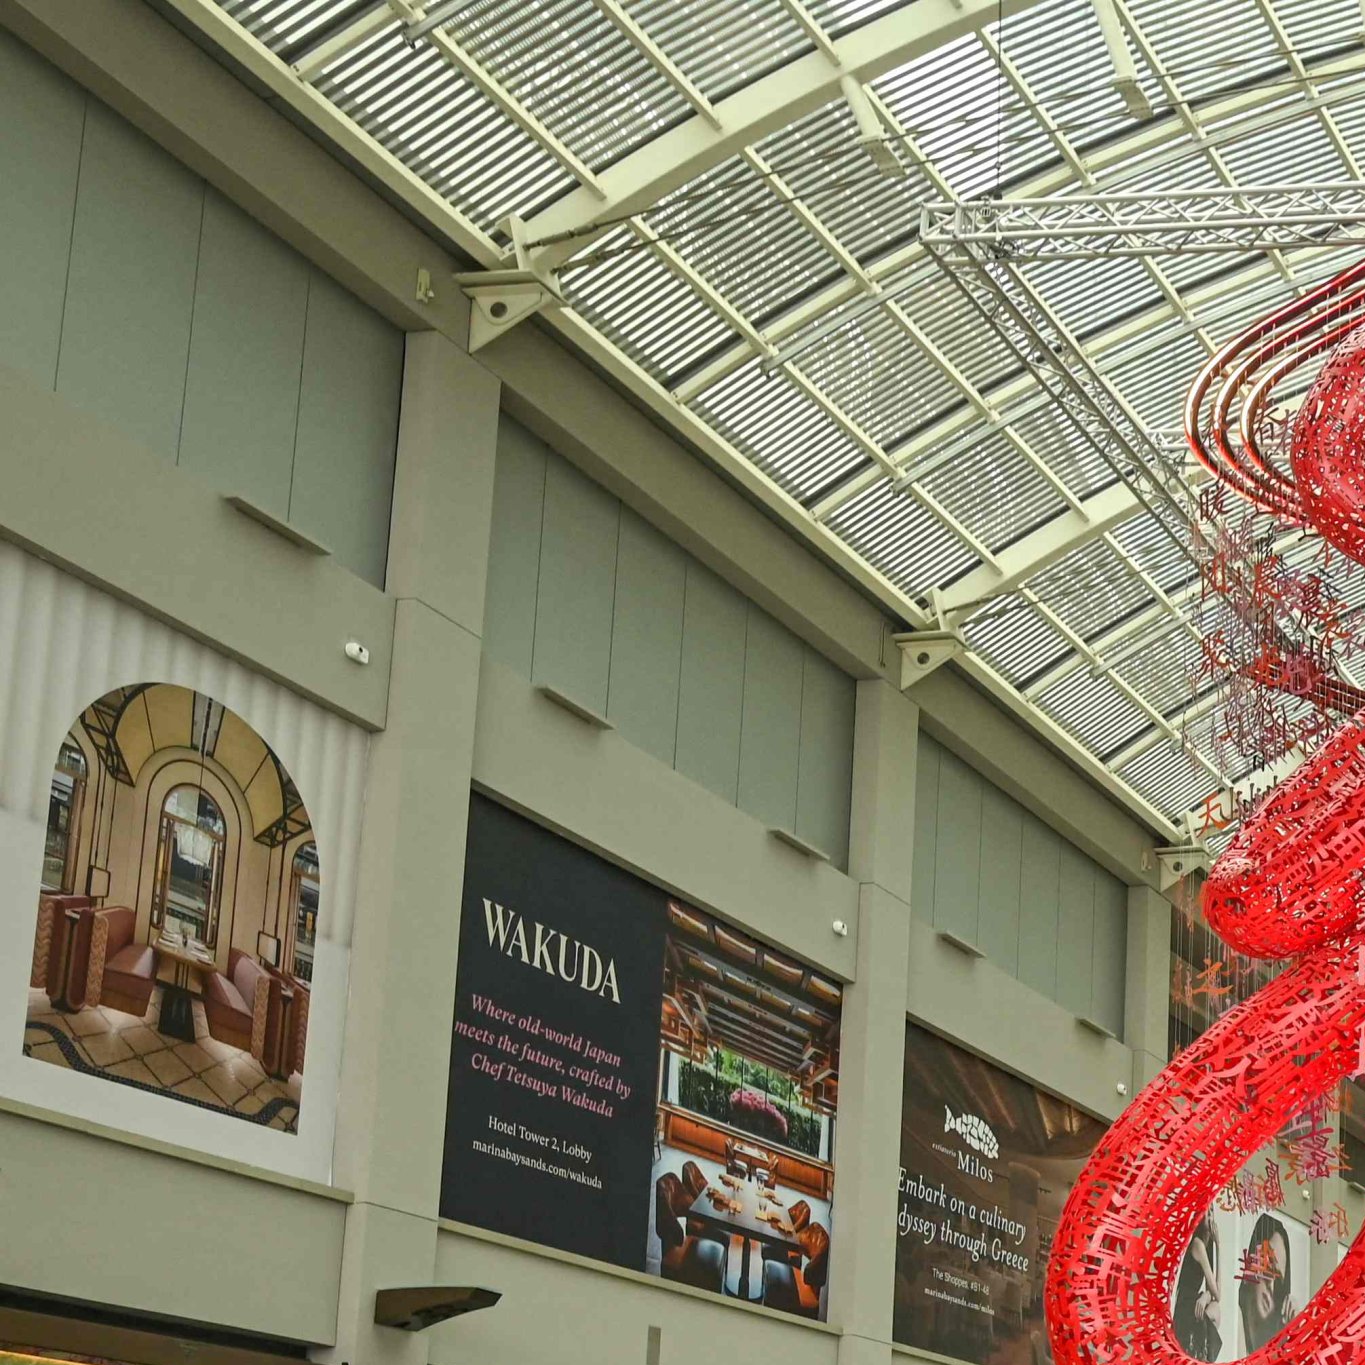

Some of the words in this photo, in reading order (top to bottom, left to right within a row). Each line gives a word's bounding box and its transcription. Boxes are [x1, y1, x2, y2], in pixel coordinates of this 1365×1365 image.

[483, 897, 621, 1004] WAKUDA
[454, 1020, 495, 1046] meets
[498, 1030, 518, 1054] the
[520, 1043, 565, 1075] future,
[569, 1064, 614, 1092] crafted
[616, 1081, 631, 1100] by
[472, 994, 515, 1026] Where
[518, 1013, 581, 1053] old-world
[583, 1040, 621, 1068] Japan
[471, 1053, 505, 1081] Chef
[506, 1065, 557, 1098] Tetsuya
[561, 1084, 613, 1118] Wakuda
[472, 1138, 602, 1189] marinabaysands.com/wakuda
[488, 1115, 516, 1137] Hotel
[519, 1125, 549, 1147] Tower
[552, 1137, 560, 1151] 2,
[563, 1141, 592, 1163] Lobby
[958, 1151, 993, 1182] Milos
[898, 1167, 946, 1208] Embark
[950, 1196, 965, 1215] on
[969, 1205, 975, 1219] a
[980, 1206, 1026, 1245] culinary
[898, 1204, 936, 1245] dyssey
[941, 1219, 986, 1262] through
[992, 1238, 1029, 1272] Greece
[933, 1268, 943, 1282] The
